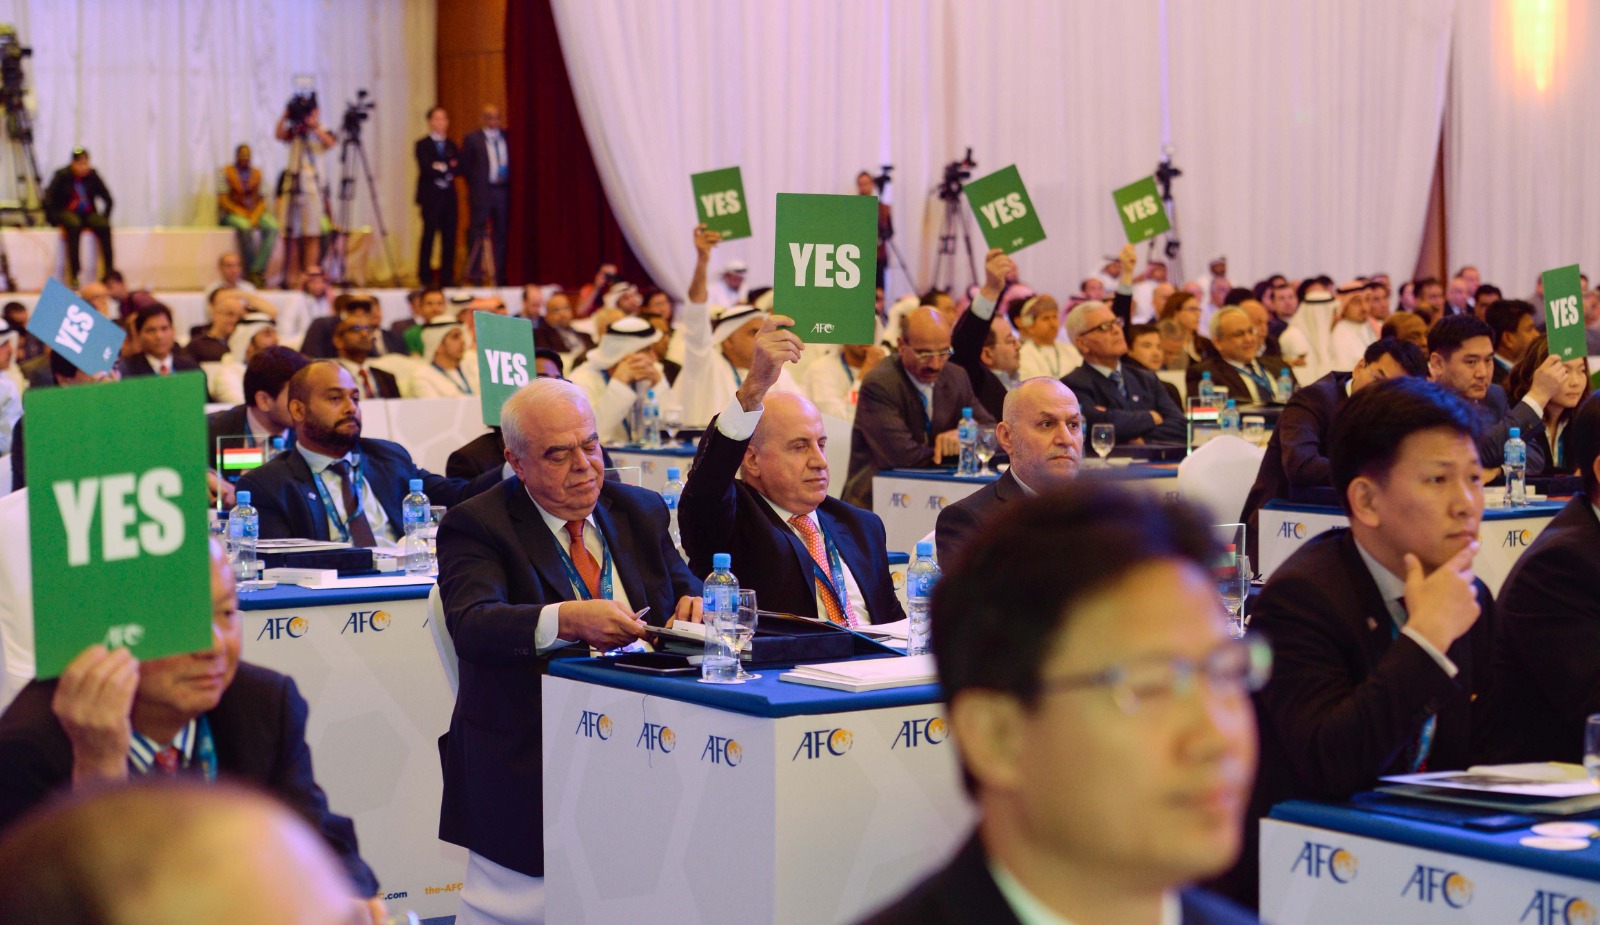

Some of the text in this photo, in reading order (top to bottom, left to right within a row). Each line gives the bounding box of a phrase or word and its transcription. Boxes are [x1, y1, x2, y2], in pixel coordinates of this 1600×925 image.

[701, 190, 741, 218] YES
[980, 192, 1027, 229] YES
[1122, 195, 1159, 224] YES
[788, 242, 861, 289] YES
[54, 304, 95, 354] YES
[811, 323, 835, 334] AFC
[1549, 295, 1580, 329] YES
[484, 348, 530, 388] YES
[52, 467, 186, 567] YES
[1277, 521, 1307, 539] AFC
[1502, 529, 1533, 548] AFC
[256, 610, 392, 641] AFC AFC
[575, 710, 743, 767] AFC AFC AFC
[791, 717, 950, 762] AFC AFC
[1291, 841, 1598, 925] AFC AFC AFC
